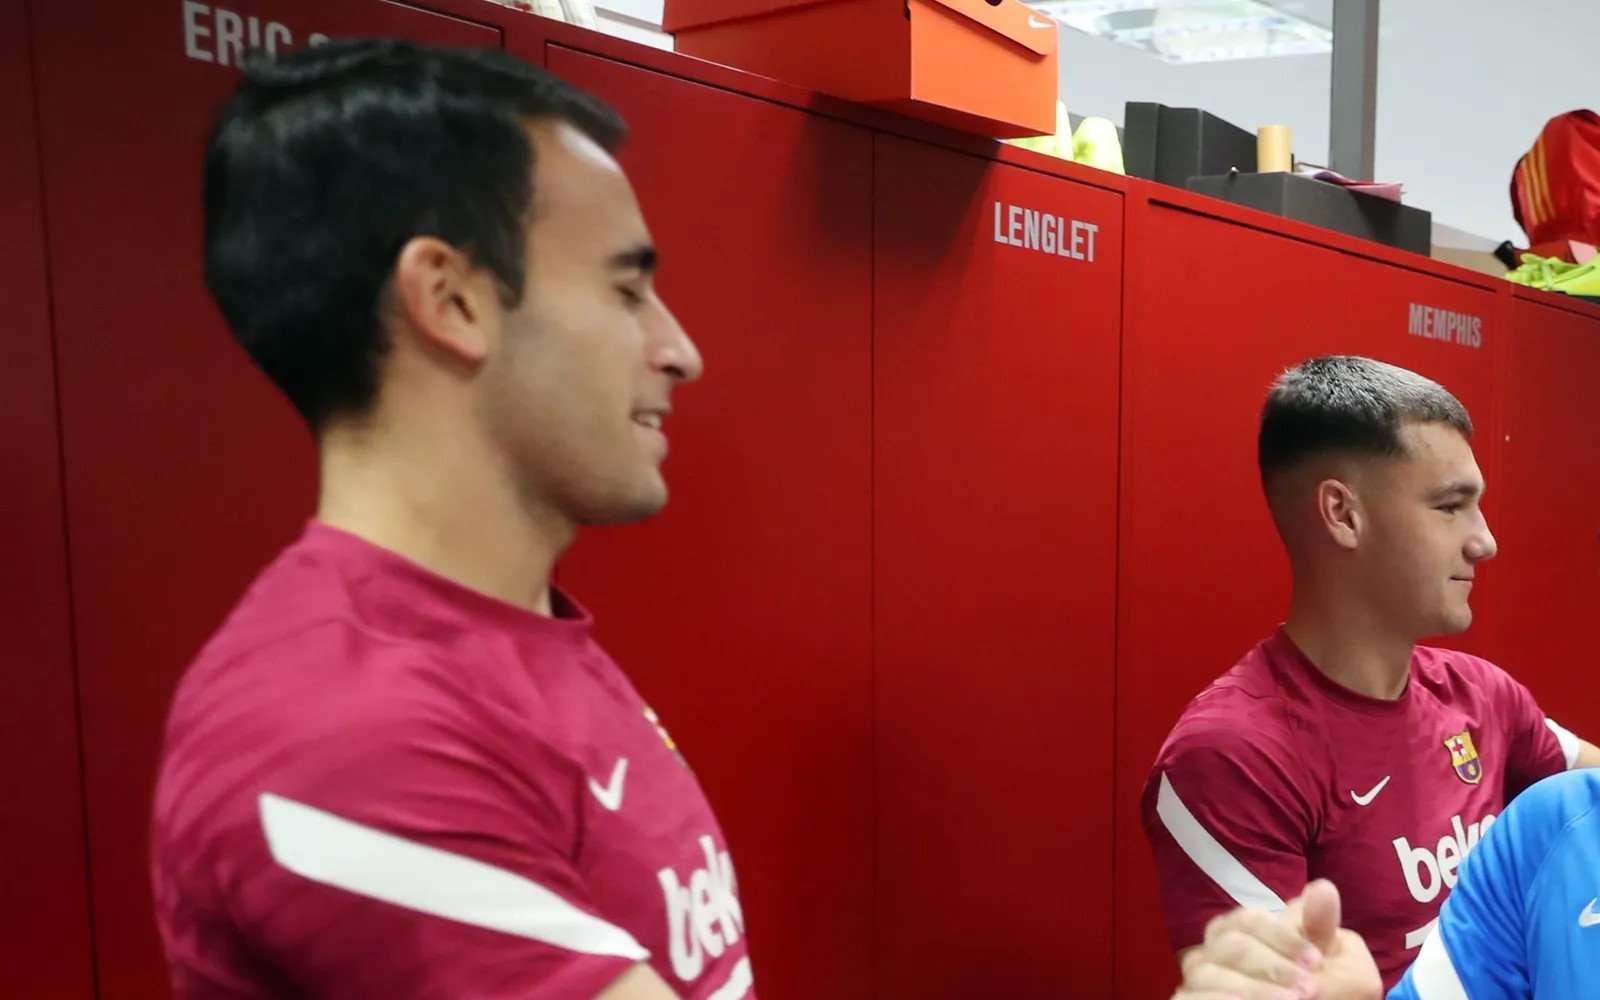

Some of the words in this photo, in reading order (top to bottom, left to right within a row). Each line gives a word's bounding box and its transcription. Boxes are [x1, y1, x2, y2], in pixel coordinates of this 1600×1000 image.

[994, 201, 1099, 262] LENGLET
[1408, 302, 1482, 349] MEMPHIS
[657, 834, 745, 982] bek
